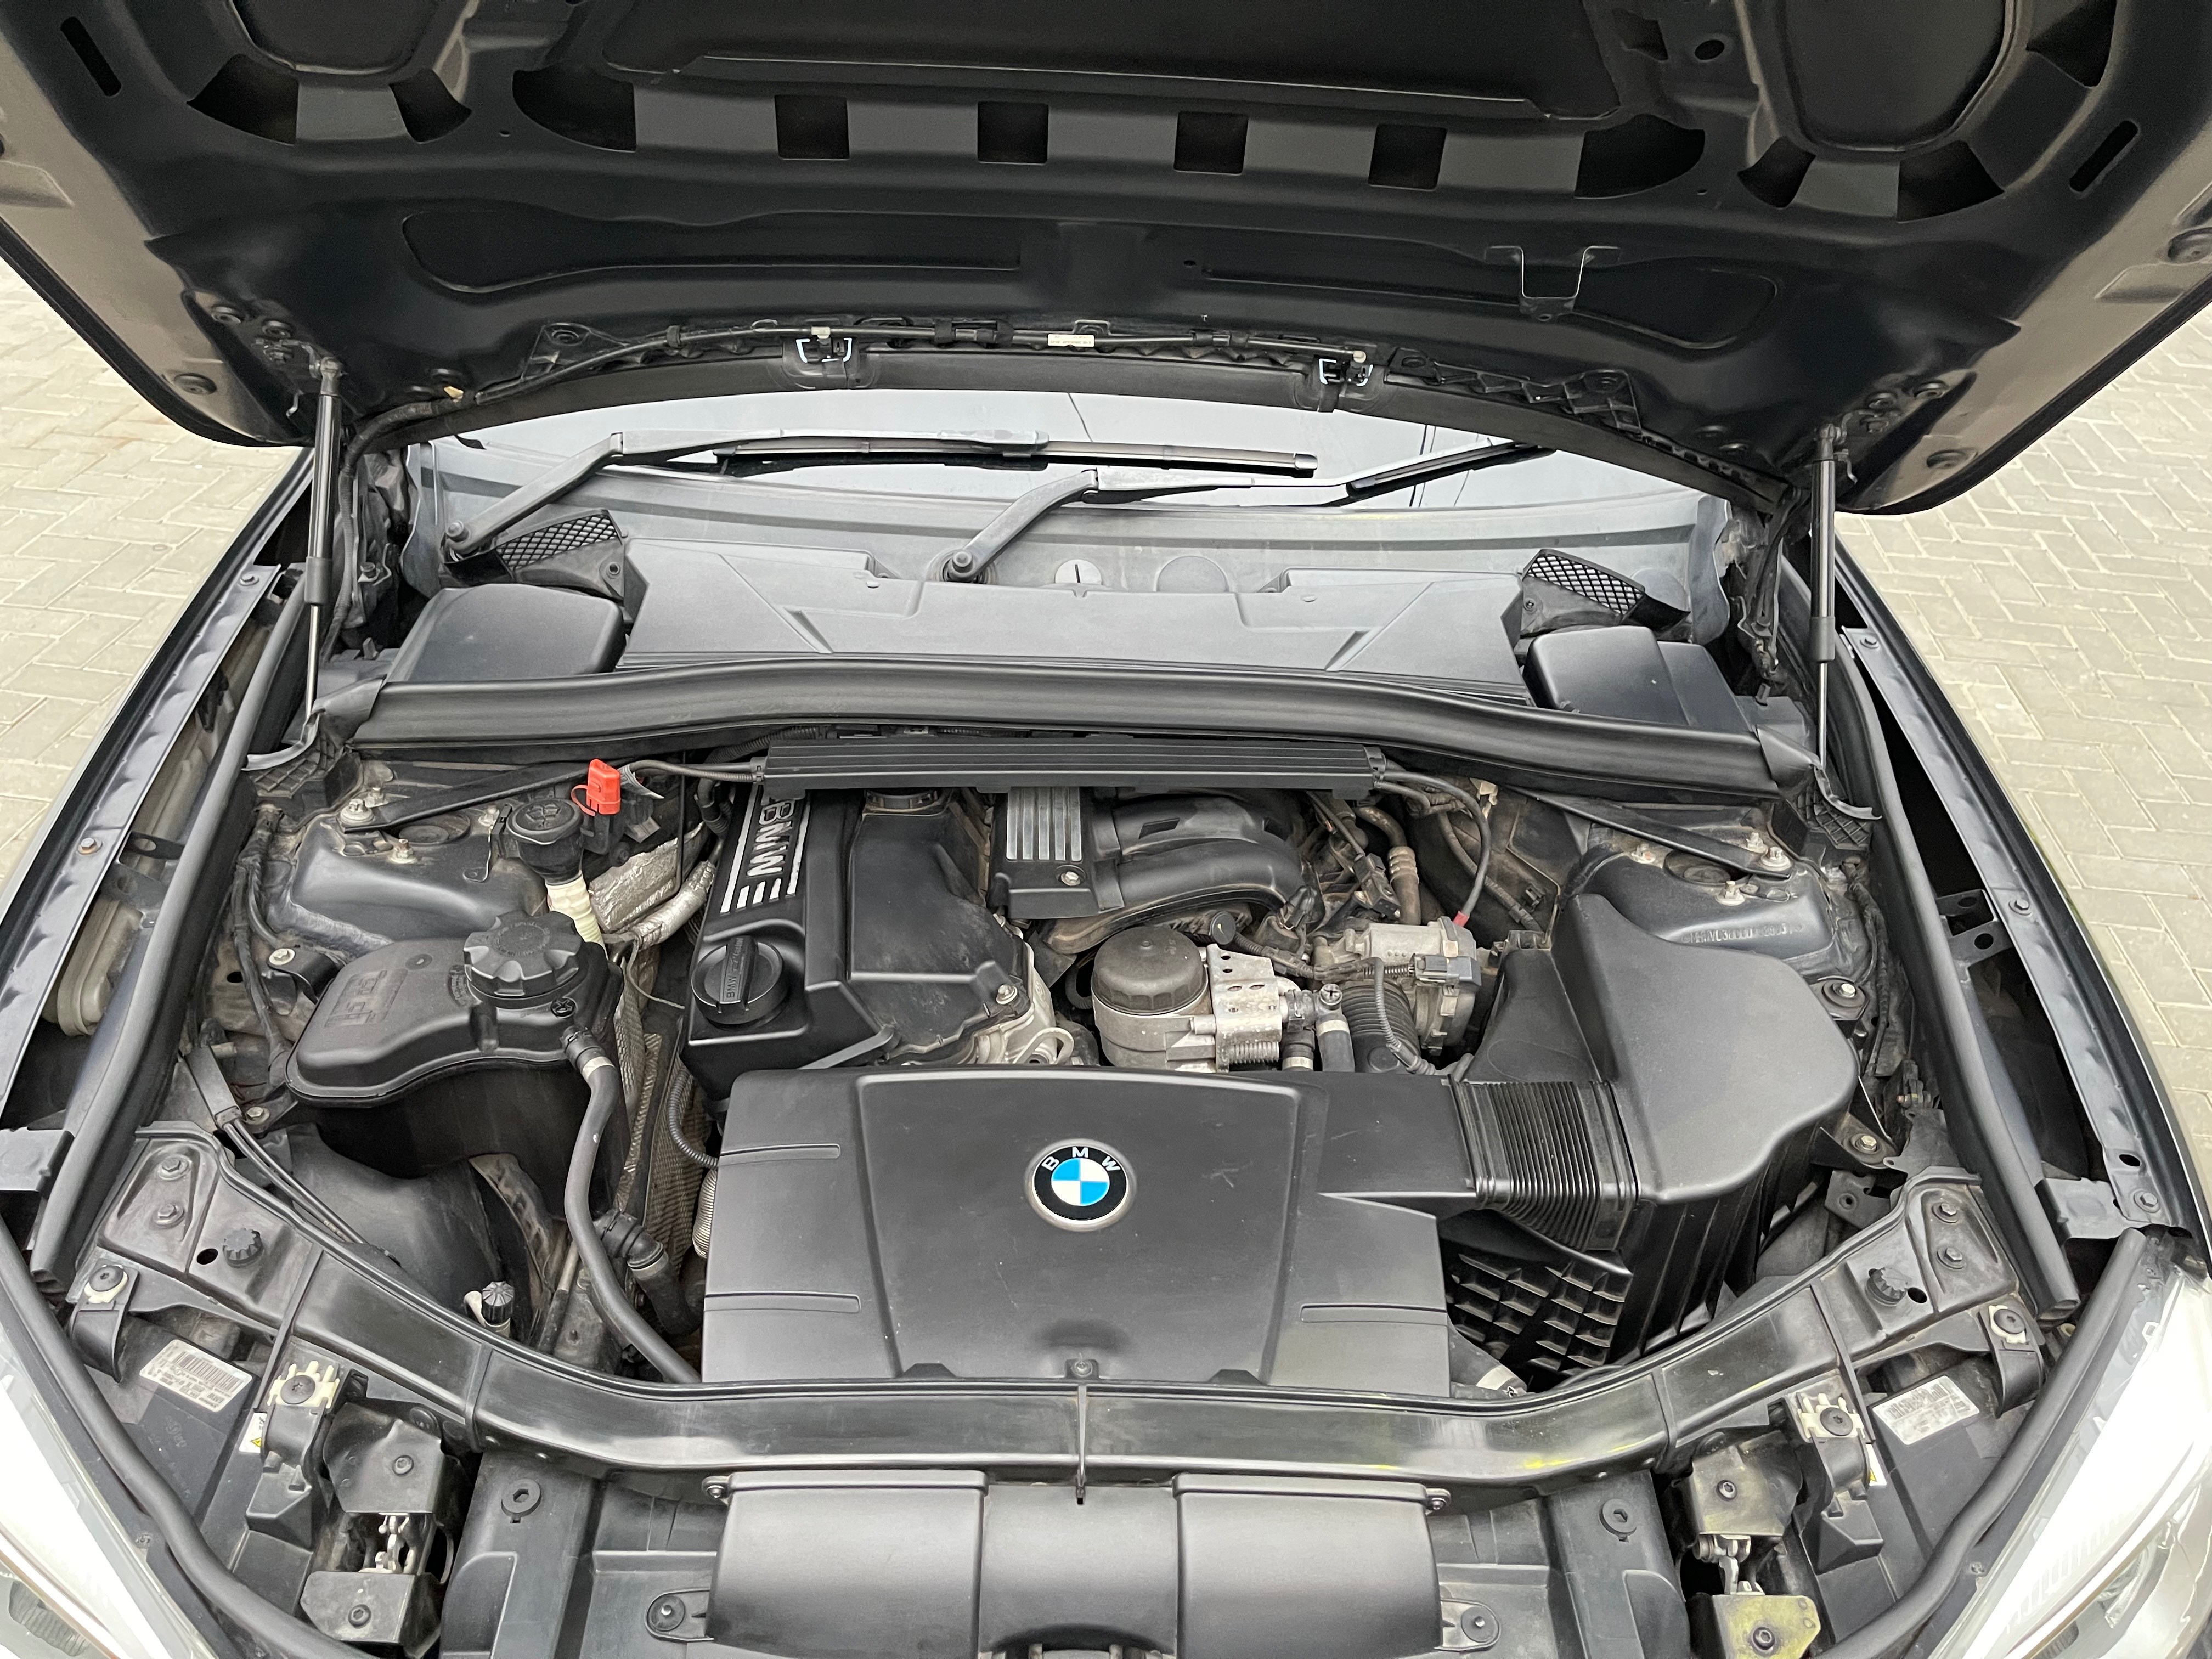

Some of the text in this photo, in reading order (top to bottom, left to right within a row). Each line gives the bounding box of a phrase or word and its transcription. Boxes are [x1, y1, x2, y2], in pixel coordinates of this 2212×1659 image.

[747, 799, 795, 876] BMW
[726, 974, 737, 998] BMW
[1041, 1146, 1121, 1172] BMW
